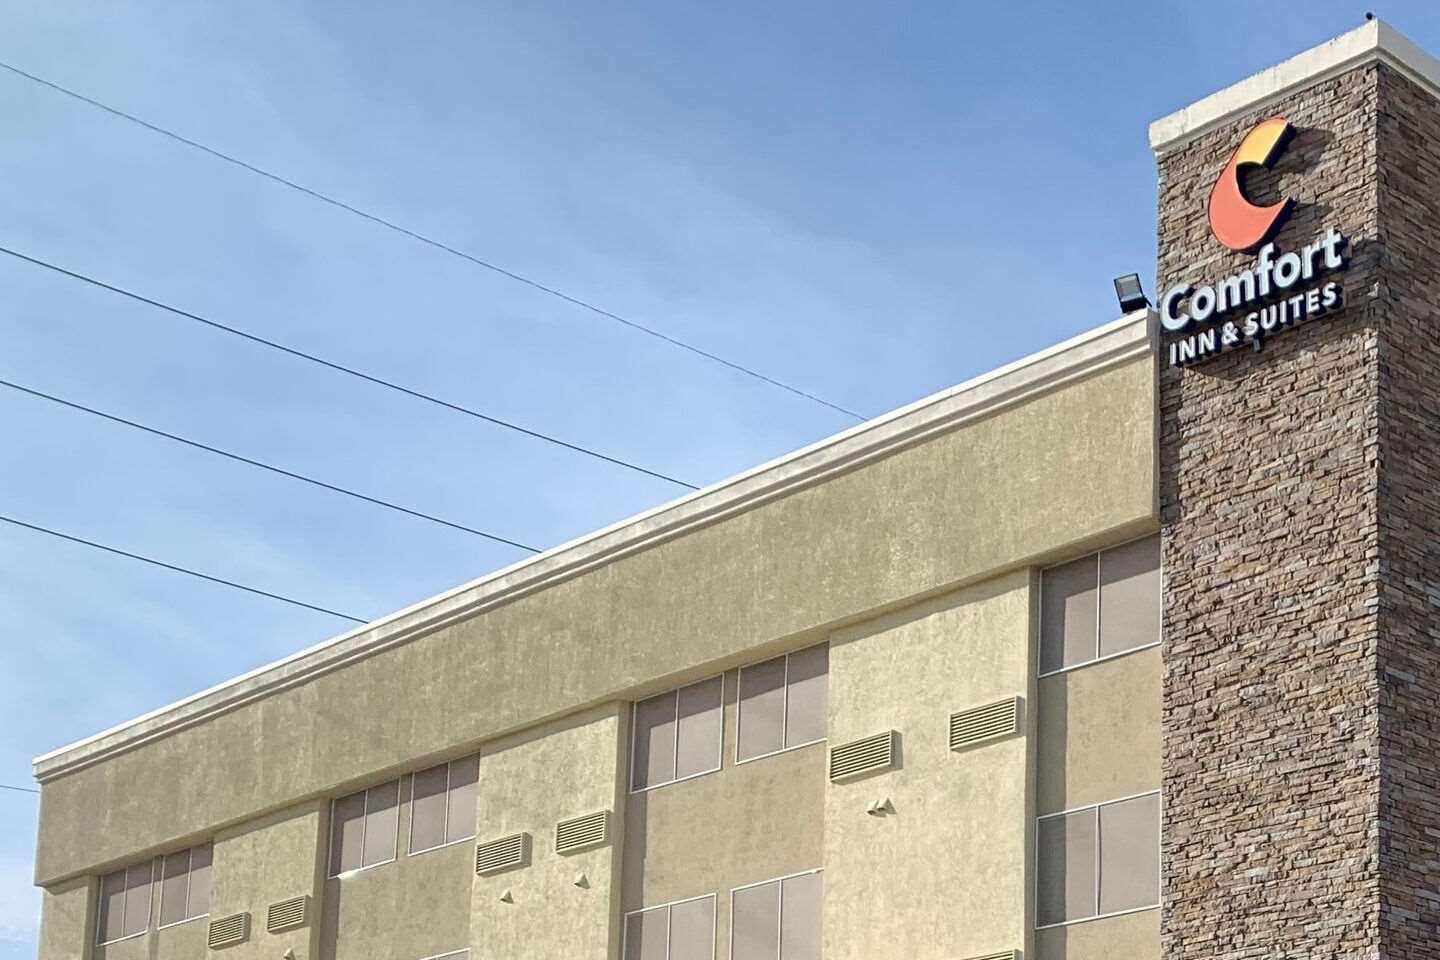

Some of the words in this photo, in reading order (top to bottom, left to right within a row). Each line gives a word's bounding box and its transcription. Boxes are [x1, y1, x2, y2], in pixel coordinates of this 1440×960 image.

[1160, 228, 1346, 332] Comfort
[1169, 328, 1217, 367] INN
[1221, 321, 1240, 347] &
[1244, 281, 1339, 337] SUITES
